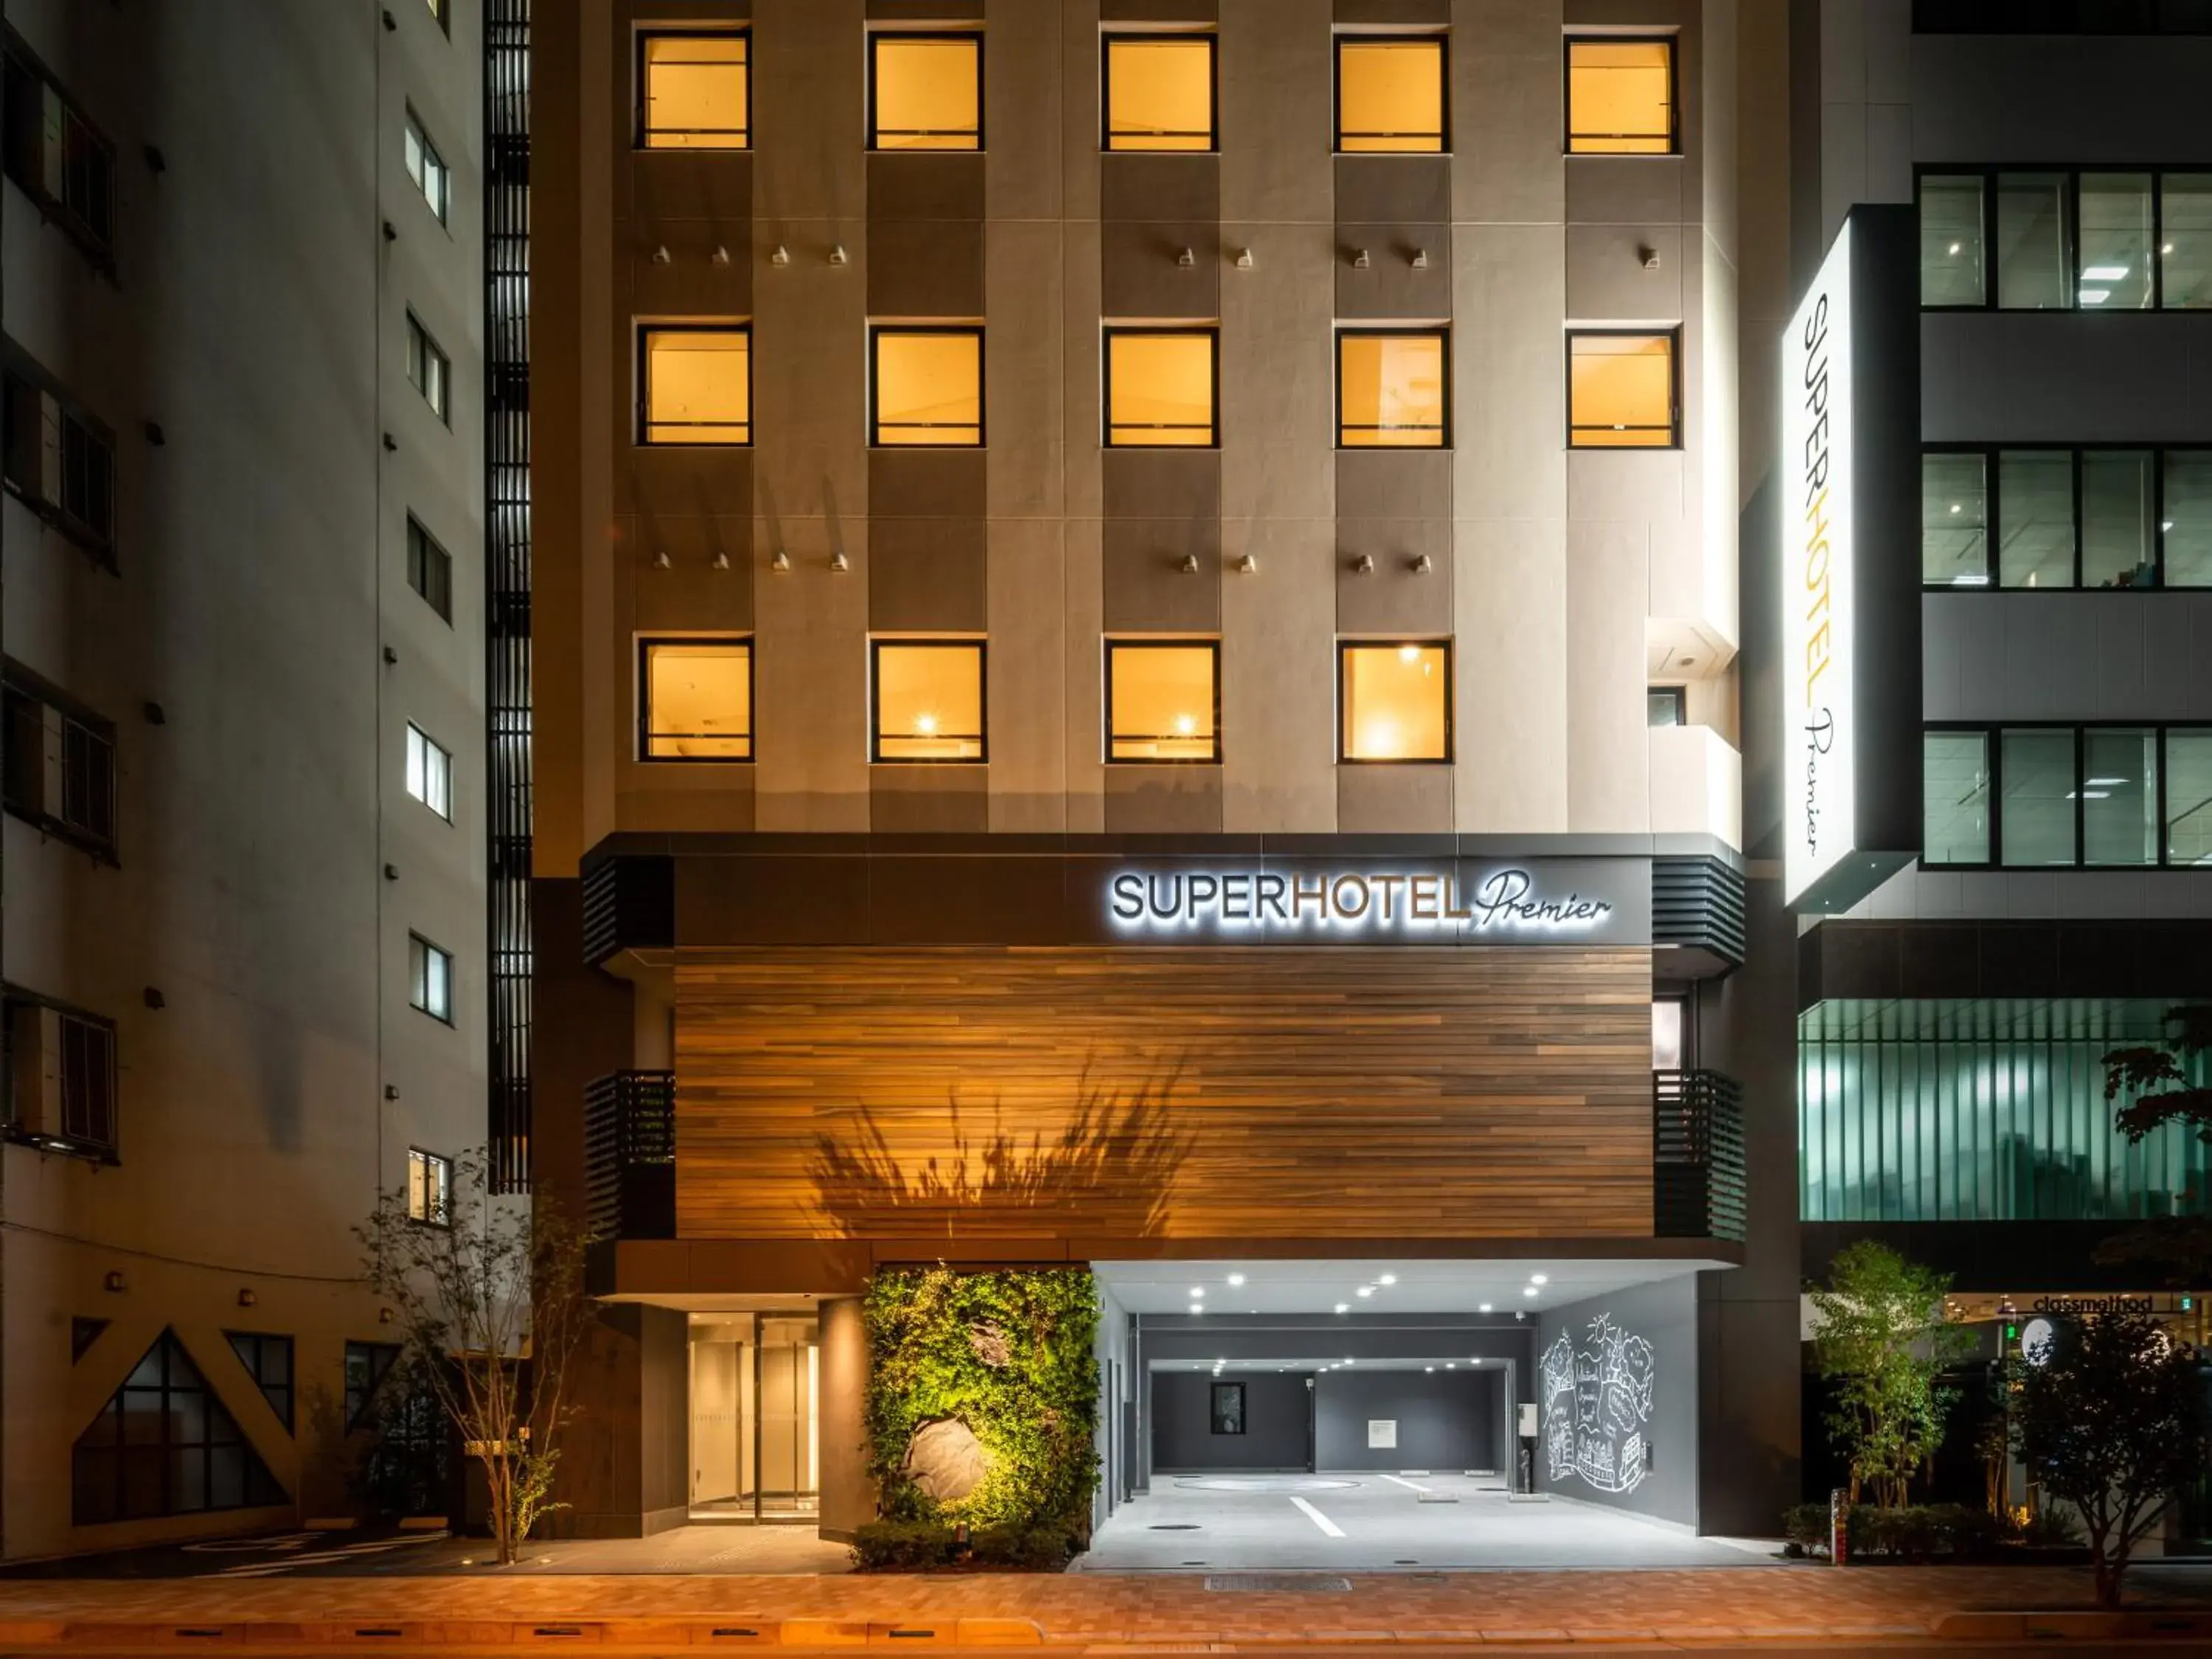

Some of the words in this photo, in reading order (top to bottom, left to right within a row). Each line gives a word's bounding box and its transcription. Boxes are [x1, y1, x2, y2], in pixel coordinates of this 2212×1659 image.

[1804, 292, 1830, 708] SUPERHOTEL
[1804, 706, 1834, 858] Premier
[1112, 874, 1471, 919] SUPERHOTEL
[1473, 869, 1613, 926] Premier
[2033, 1295, 2153, 1312] classmethod
